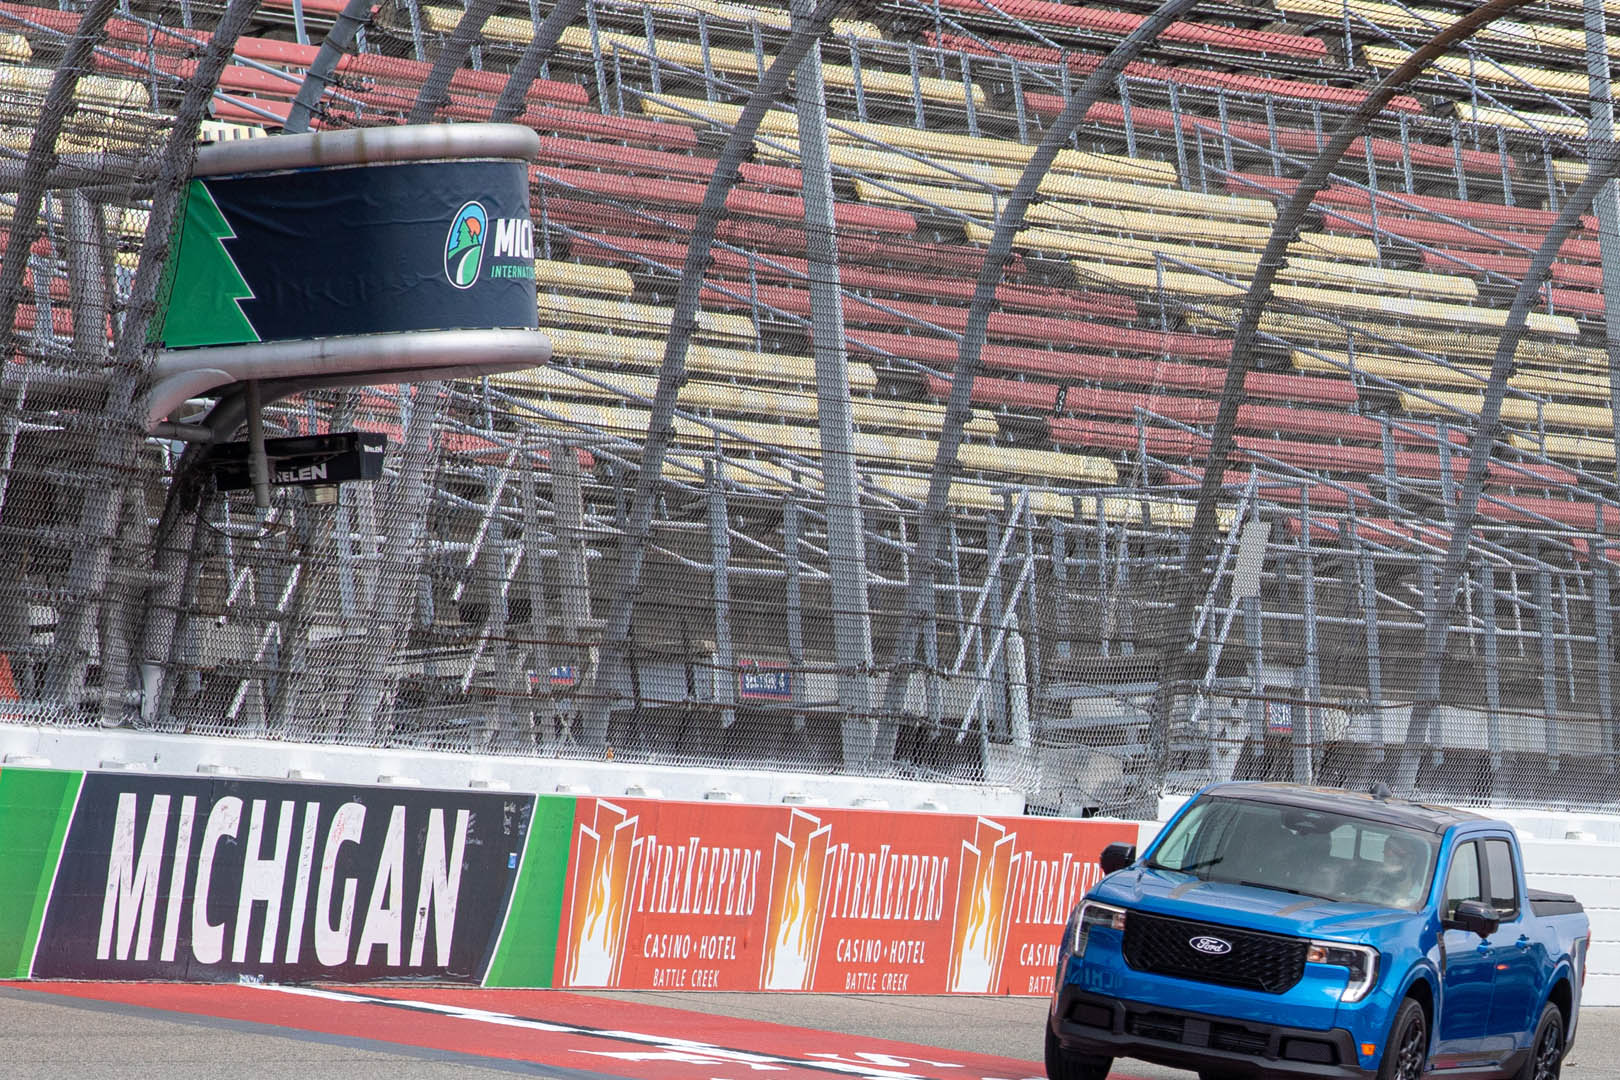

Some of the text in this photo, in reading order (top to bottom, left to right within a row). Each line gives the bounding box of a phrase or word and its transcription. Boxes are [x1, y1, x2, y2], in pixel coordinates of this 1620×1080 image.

[97, 792, 470, 967] MICHIGAN
[638, 835, 761, 916] FIREKEEPERS
[831, 843, 949, 921] FIREKEEPERS
[643, 933, 737, 960] CASINO HOTEL
[836, 938, 926, 965] CASINO HOTEL
[1195, 938, 1225, 952] Ford
[653, 967, 720, 988] BATTLE CREEK
[845, 972, 909, 992] BATTLE CREEK
